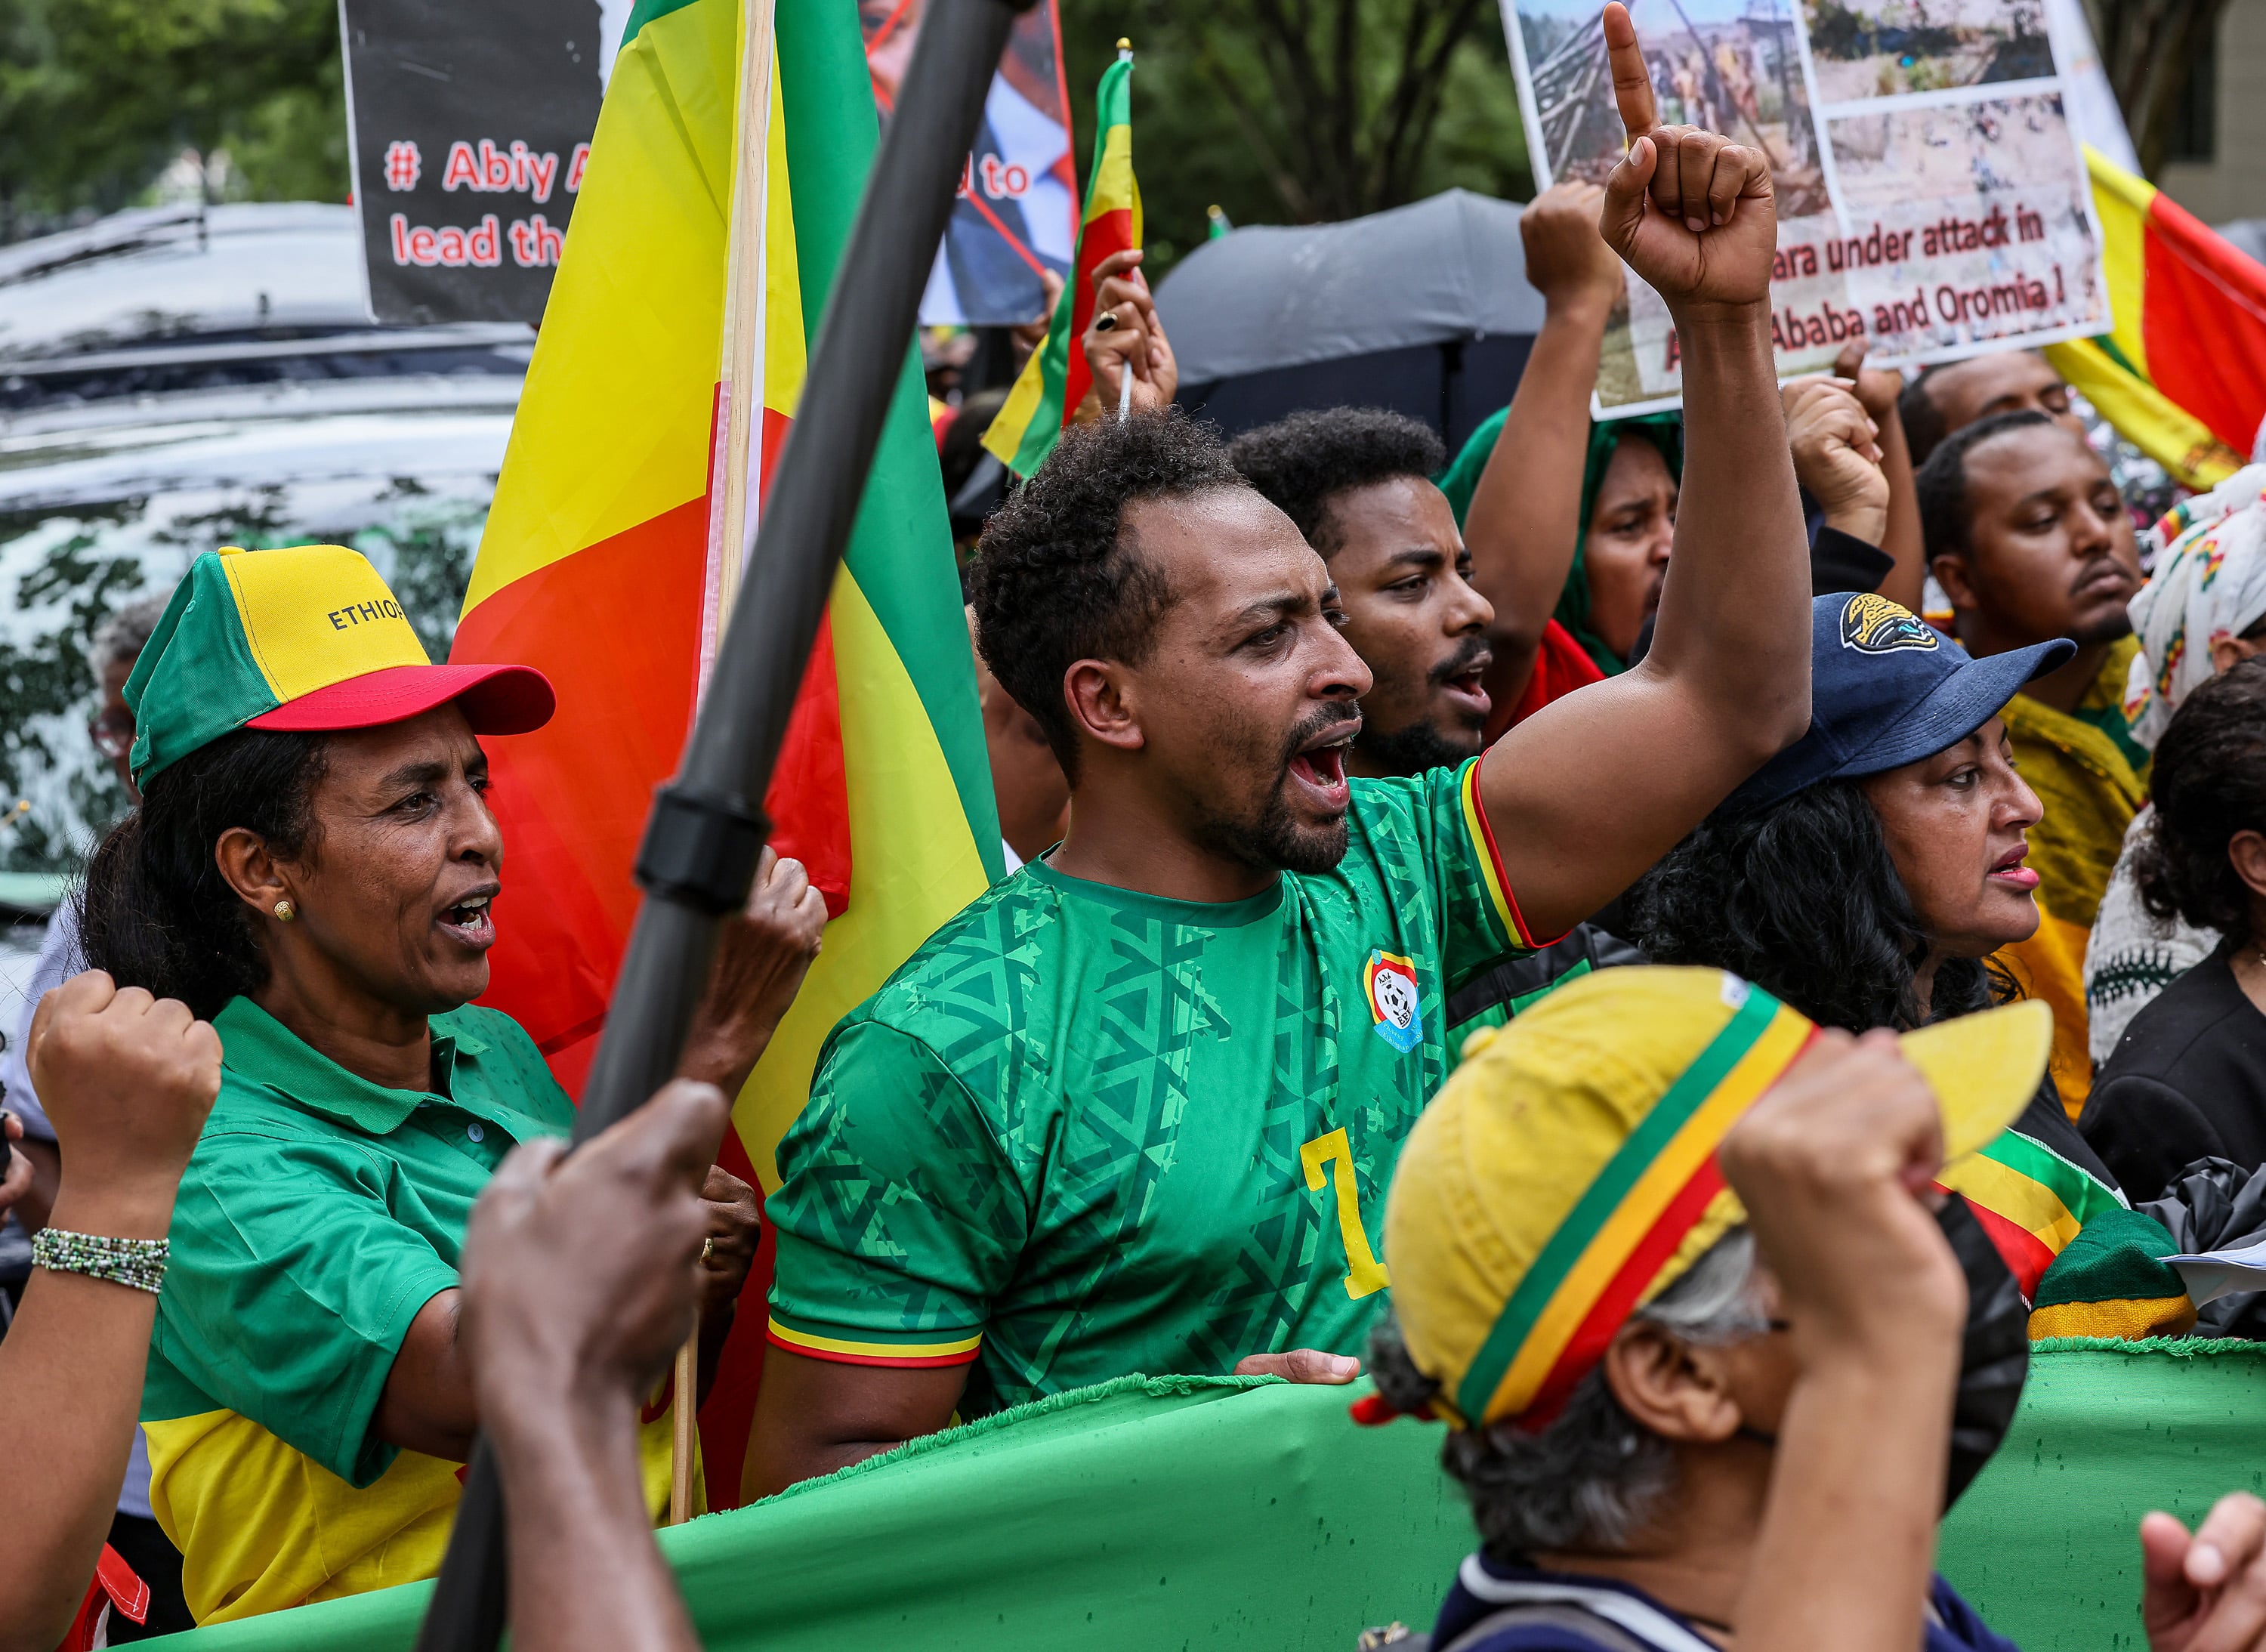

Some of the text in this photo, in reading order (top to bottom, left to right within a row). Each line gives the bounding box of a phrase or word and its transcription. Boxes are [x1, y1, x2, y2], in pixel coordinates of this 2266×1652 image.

[387, 144, 419, 189] #
[444, 140, 557, 202] Abiy
[980, 155, 1029, 199] to
[391, 215, 500, 264] lead
[1826, 223, 1913, 273] under
[1923, 205, 2010, 256] attack
[2016, 202, 2044, 242] in
[1873, 288, 1931, 333] and
[1937, 273, 2048, 323] Oromia
